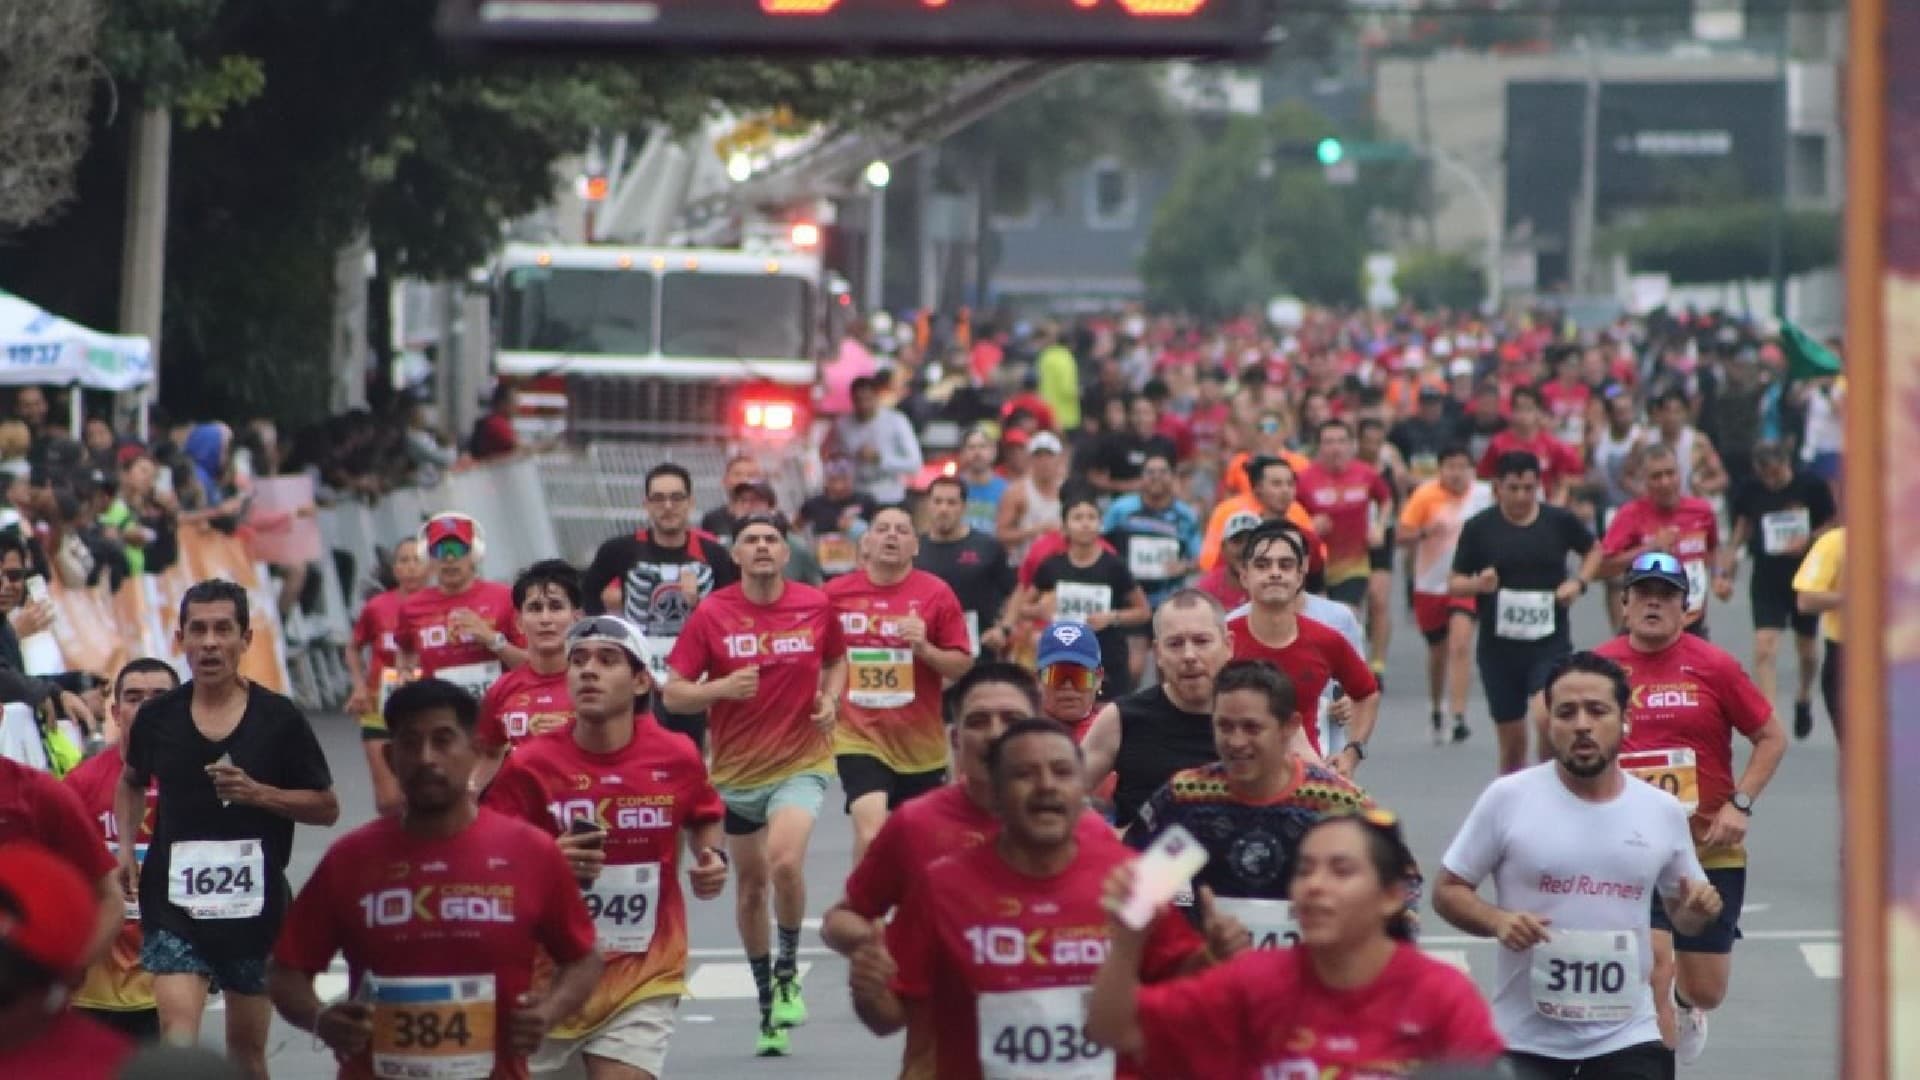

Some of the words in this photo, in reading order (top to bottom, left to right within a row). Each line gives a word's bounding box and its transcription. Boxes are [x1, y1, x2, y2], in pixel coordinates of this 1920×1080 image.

[1503, 606, 1550, 626] 4259
[722, 633, 768, 658] 10K
[857, 666, 899, 690] 536
[1647, 690, 1699, 709] GDL
[615, 795, 675, 807] COMUDE
[617, 807, 672, 830] GDL
[181, 866, 253, 895] 1624
[1540, 873, 1574, 893] Red
[1576, 875, 1645, 900] Runners
[359, 887, 435, 928] 10K
[440, 896, 516, 922] GDL
[962, 926, 1048, 966] 10K
[1546, 957, 1625, 994] 3110
[392, 1011, 470, 1048] 384
